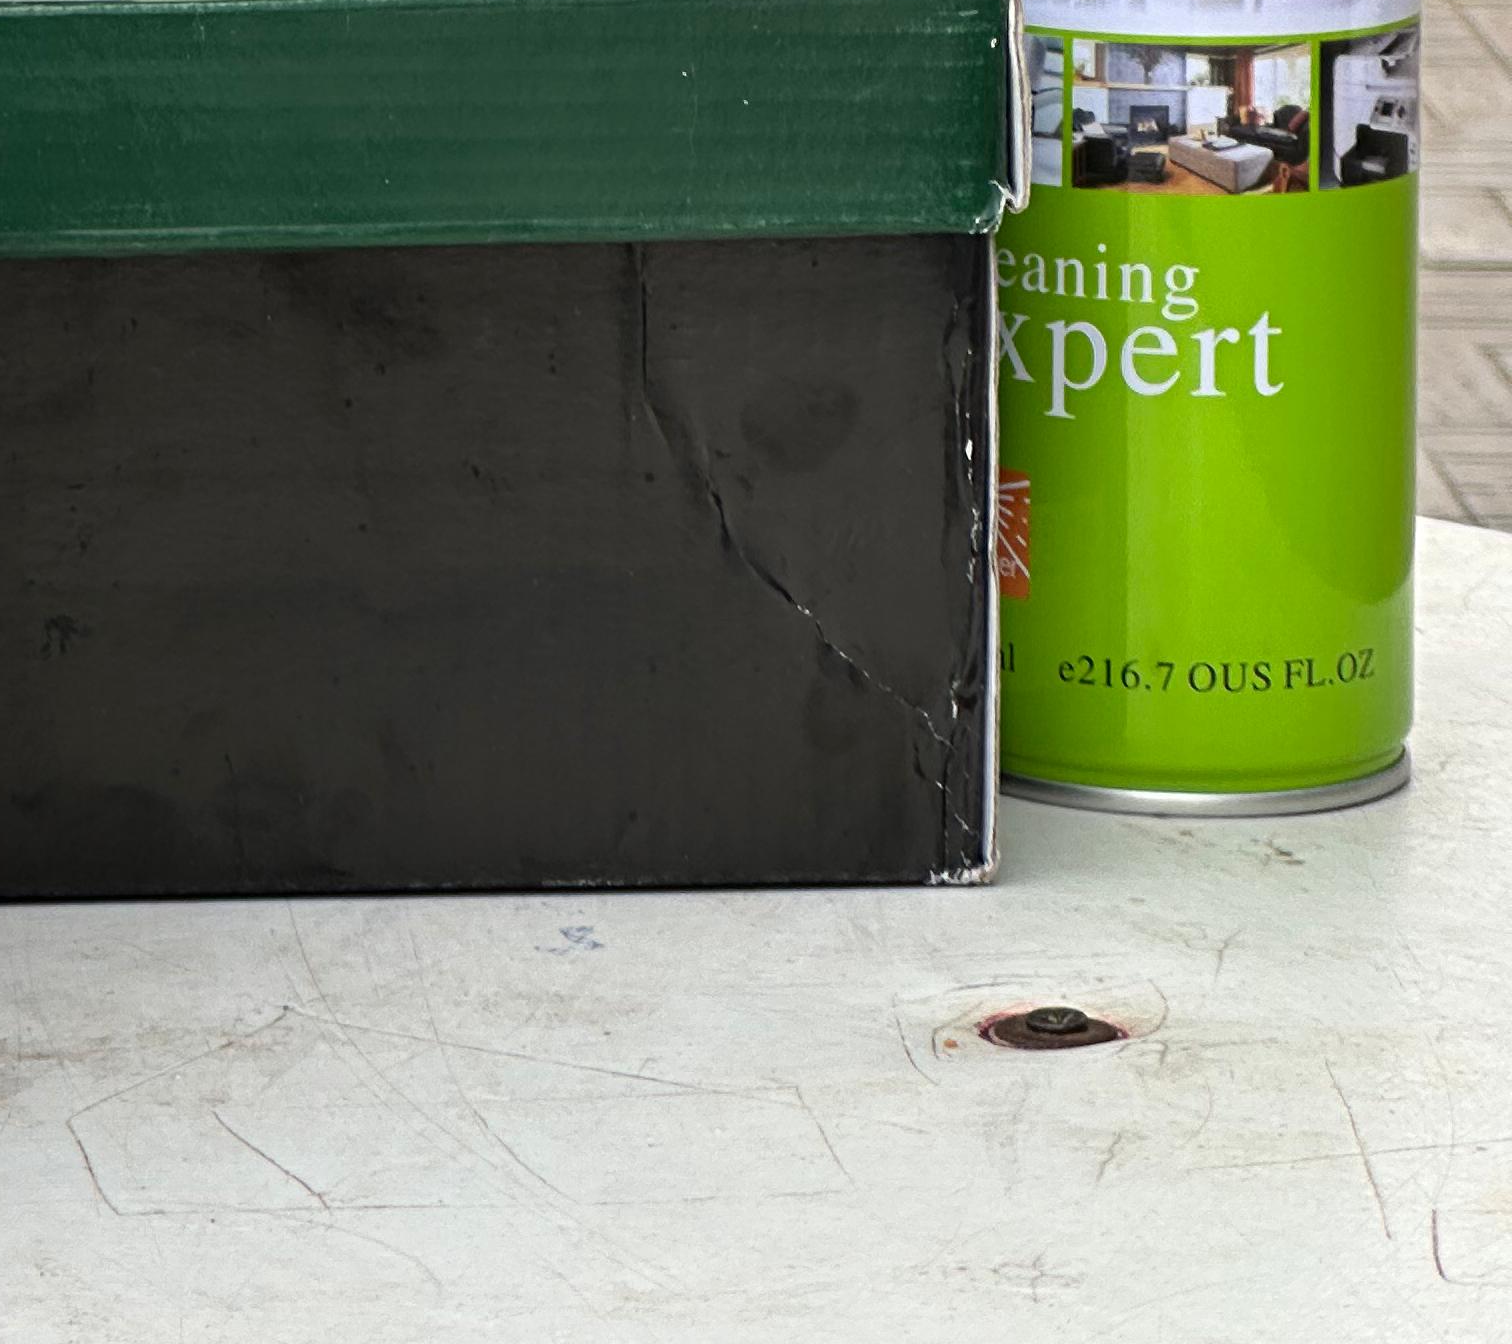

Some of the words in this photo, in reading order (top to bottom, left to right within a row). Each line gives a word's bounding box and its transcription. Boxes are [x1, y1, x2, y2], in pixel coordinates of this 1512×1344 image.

[996, 242, 1200, 322] eaning
[998, 311, 1285, 420] xpert
[1283, 647, 1377, 691] FL.OZ
